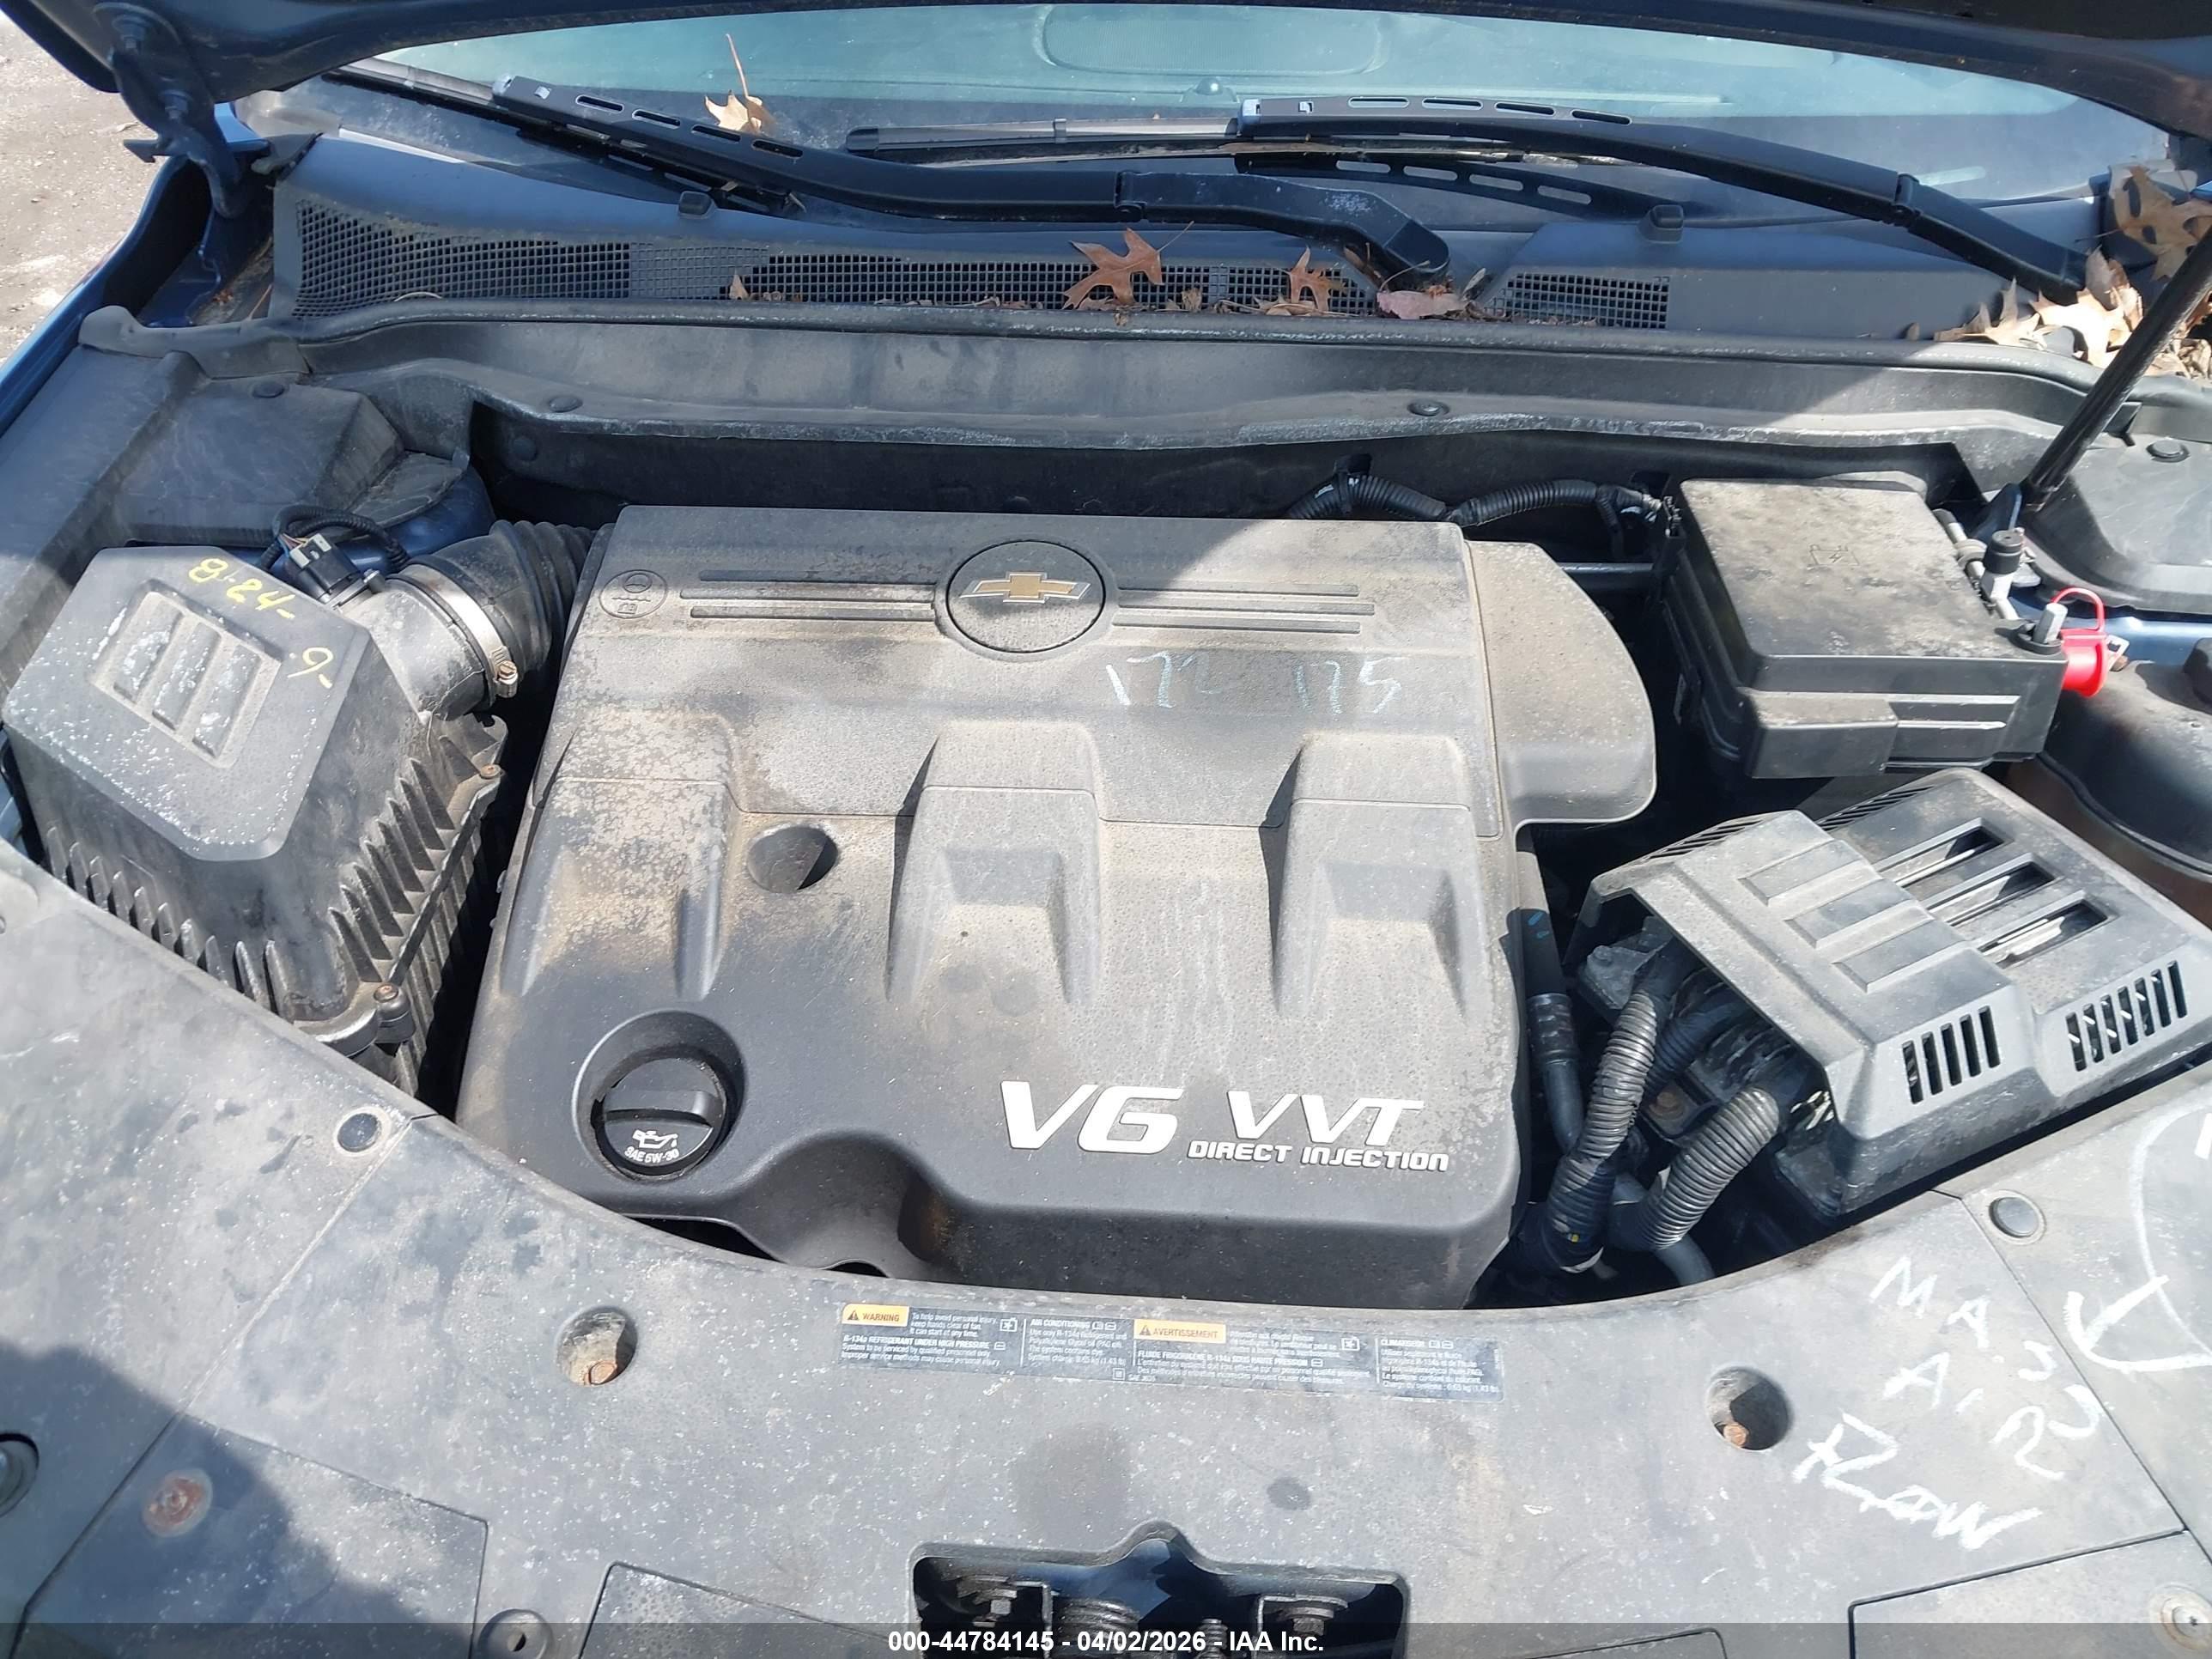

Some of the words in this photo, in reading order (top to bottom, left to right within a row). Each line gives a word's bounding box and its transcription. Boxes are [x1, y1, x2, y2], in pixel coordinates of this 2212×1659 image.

[1000, 1081, 1183, 1154] V6
[1227, 1091, 1425, 1147] VVT
[624, 1146, 646, 1162] SAE
[644, 1148, 680, 1164] 5W-30
[1187, 1140, 1292, 1164] DIRECT
[1301, 1147, 1449, 1172] INJECTION
[862, 1312, 900, 1322] WARNING
[1153, 1328, 1218, 1338] AVERTISSEMENT
[869, 1336, 914, 1346] REFRIGERANT
[915, 1338, 938, 1346] UNDER
[955, 1340, 990, 1348] PRESSURE
